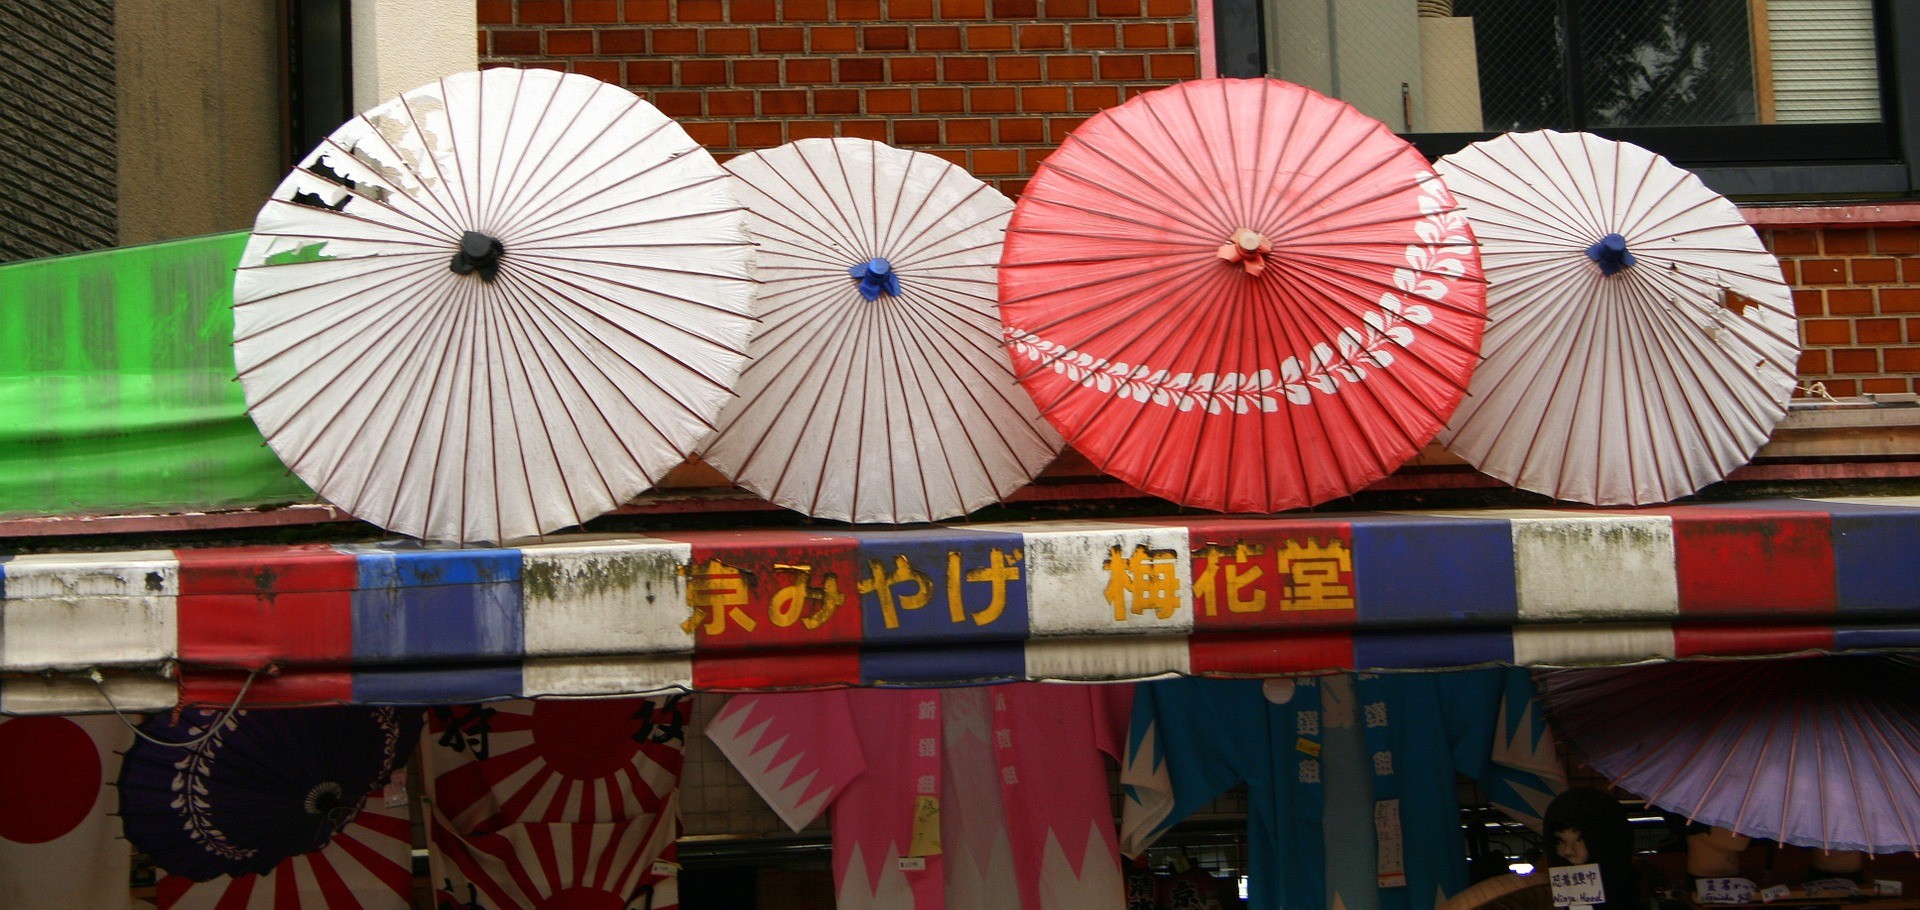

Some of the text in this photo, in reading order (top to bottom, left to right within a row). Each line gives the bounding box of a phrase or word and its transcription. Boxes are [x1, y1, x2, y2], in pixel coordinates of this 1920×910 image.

[675, 538, 1353, 636] 京みやげ 梅花堂
[1580, 890, 1602, 903] Hood
